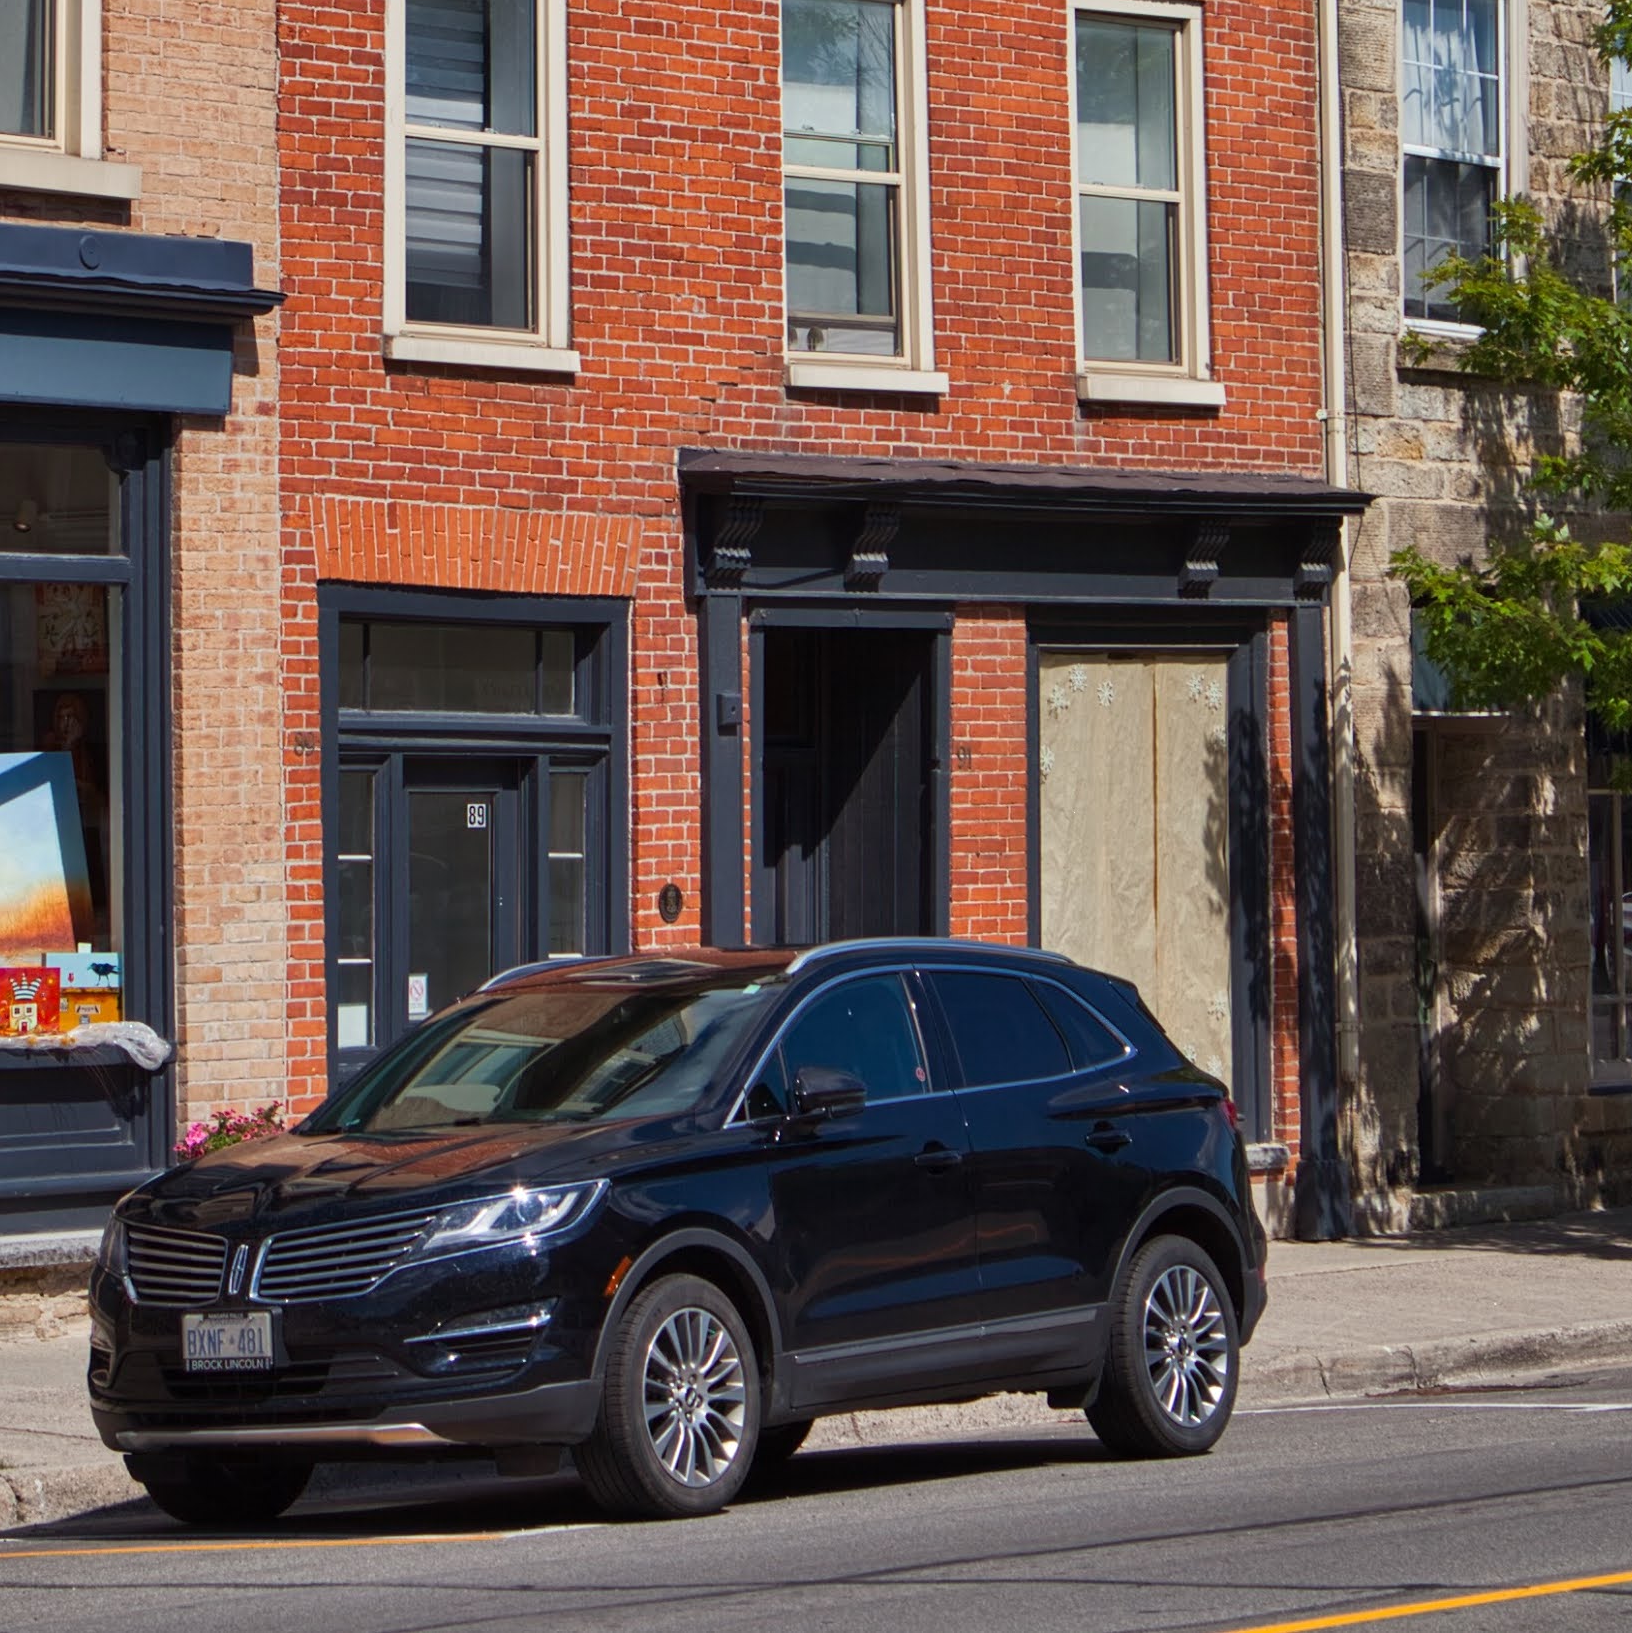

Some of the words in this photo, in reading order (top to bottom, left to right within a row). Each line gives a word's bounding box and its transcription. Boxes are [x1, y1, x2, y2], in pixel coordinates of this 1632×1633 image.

[468, 805, 485, 826] 89
[187, 1328, 225, 1357] BXNF
[238, 1327, 265, 1355] 481
[192, 1359, 222, 1370] BROCK
[225, 1359, 264, 1369] LINCOLN
